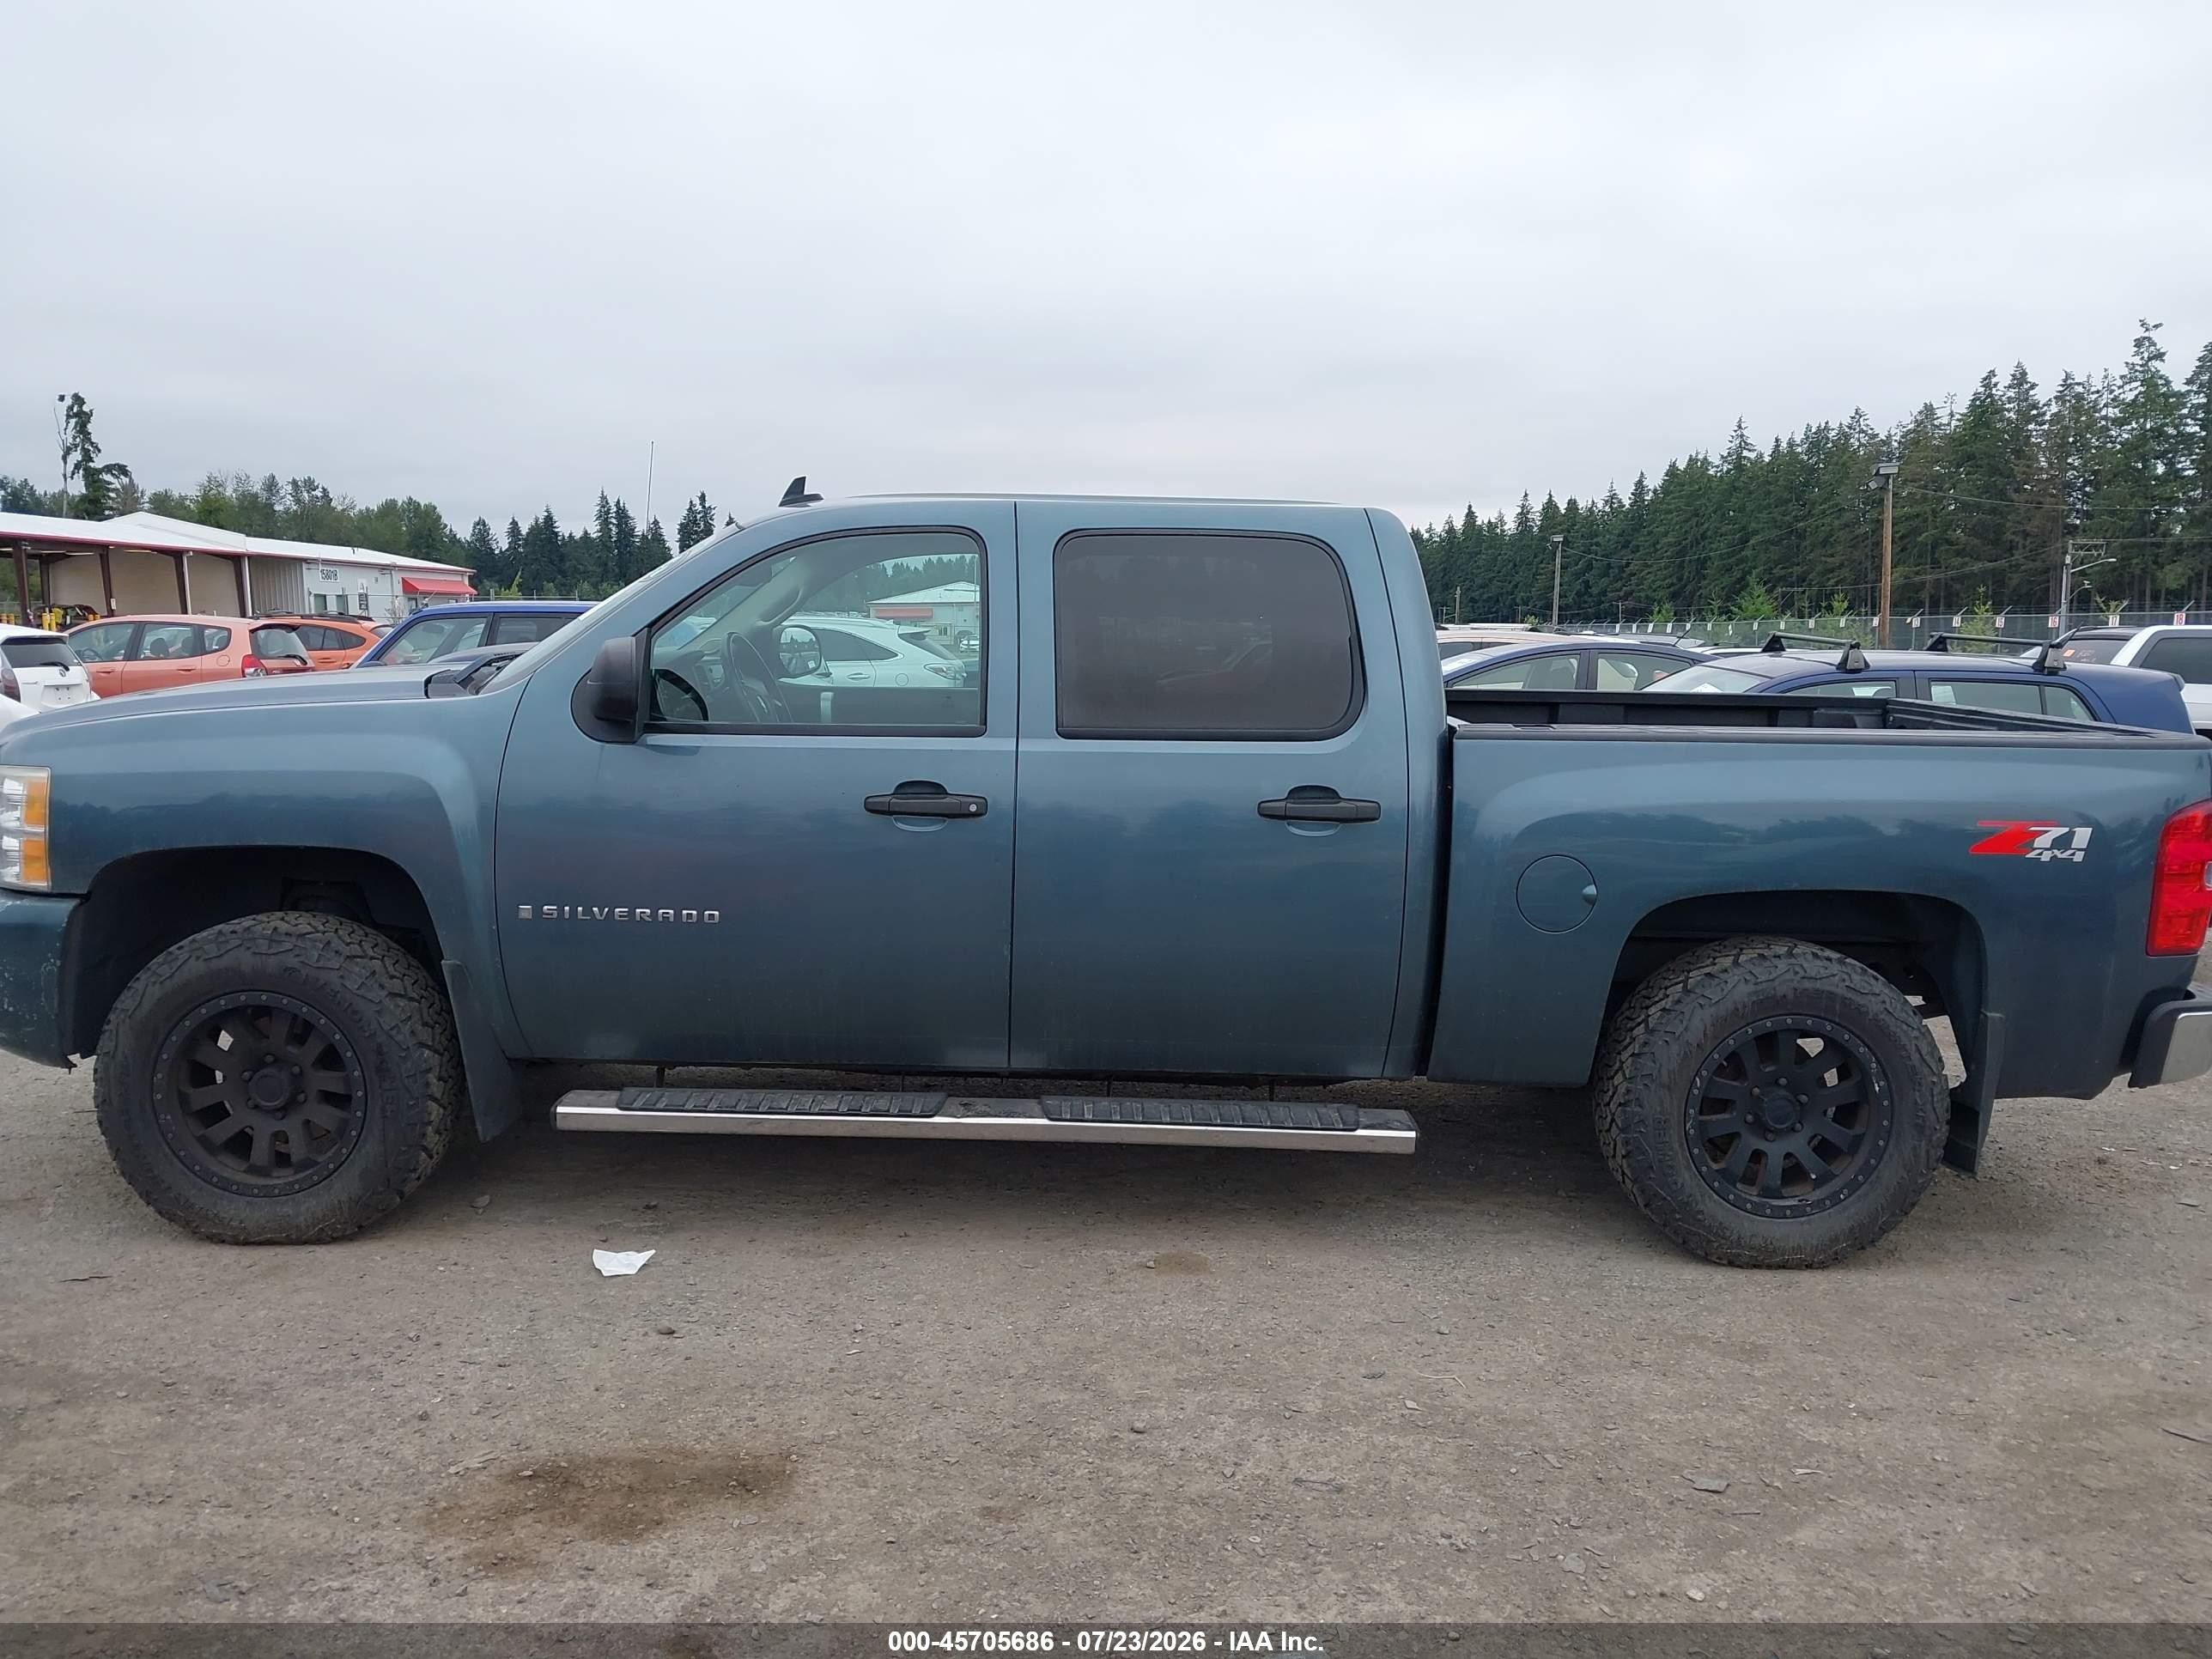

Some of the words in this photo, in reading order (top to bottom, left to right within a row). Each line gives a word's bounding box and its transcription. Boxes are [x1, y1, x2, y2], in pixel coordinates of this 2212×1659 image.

[320, 568, 338, 580] 15801B
[2051, 617, 2057, 627] 16
[2176, 614, 2184, 625] 18
[1969, 820, 2094, 856] Z71
[543, 905, 720, 924] SILVERADO
